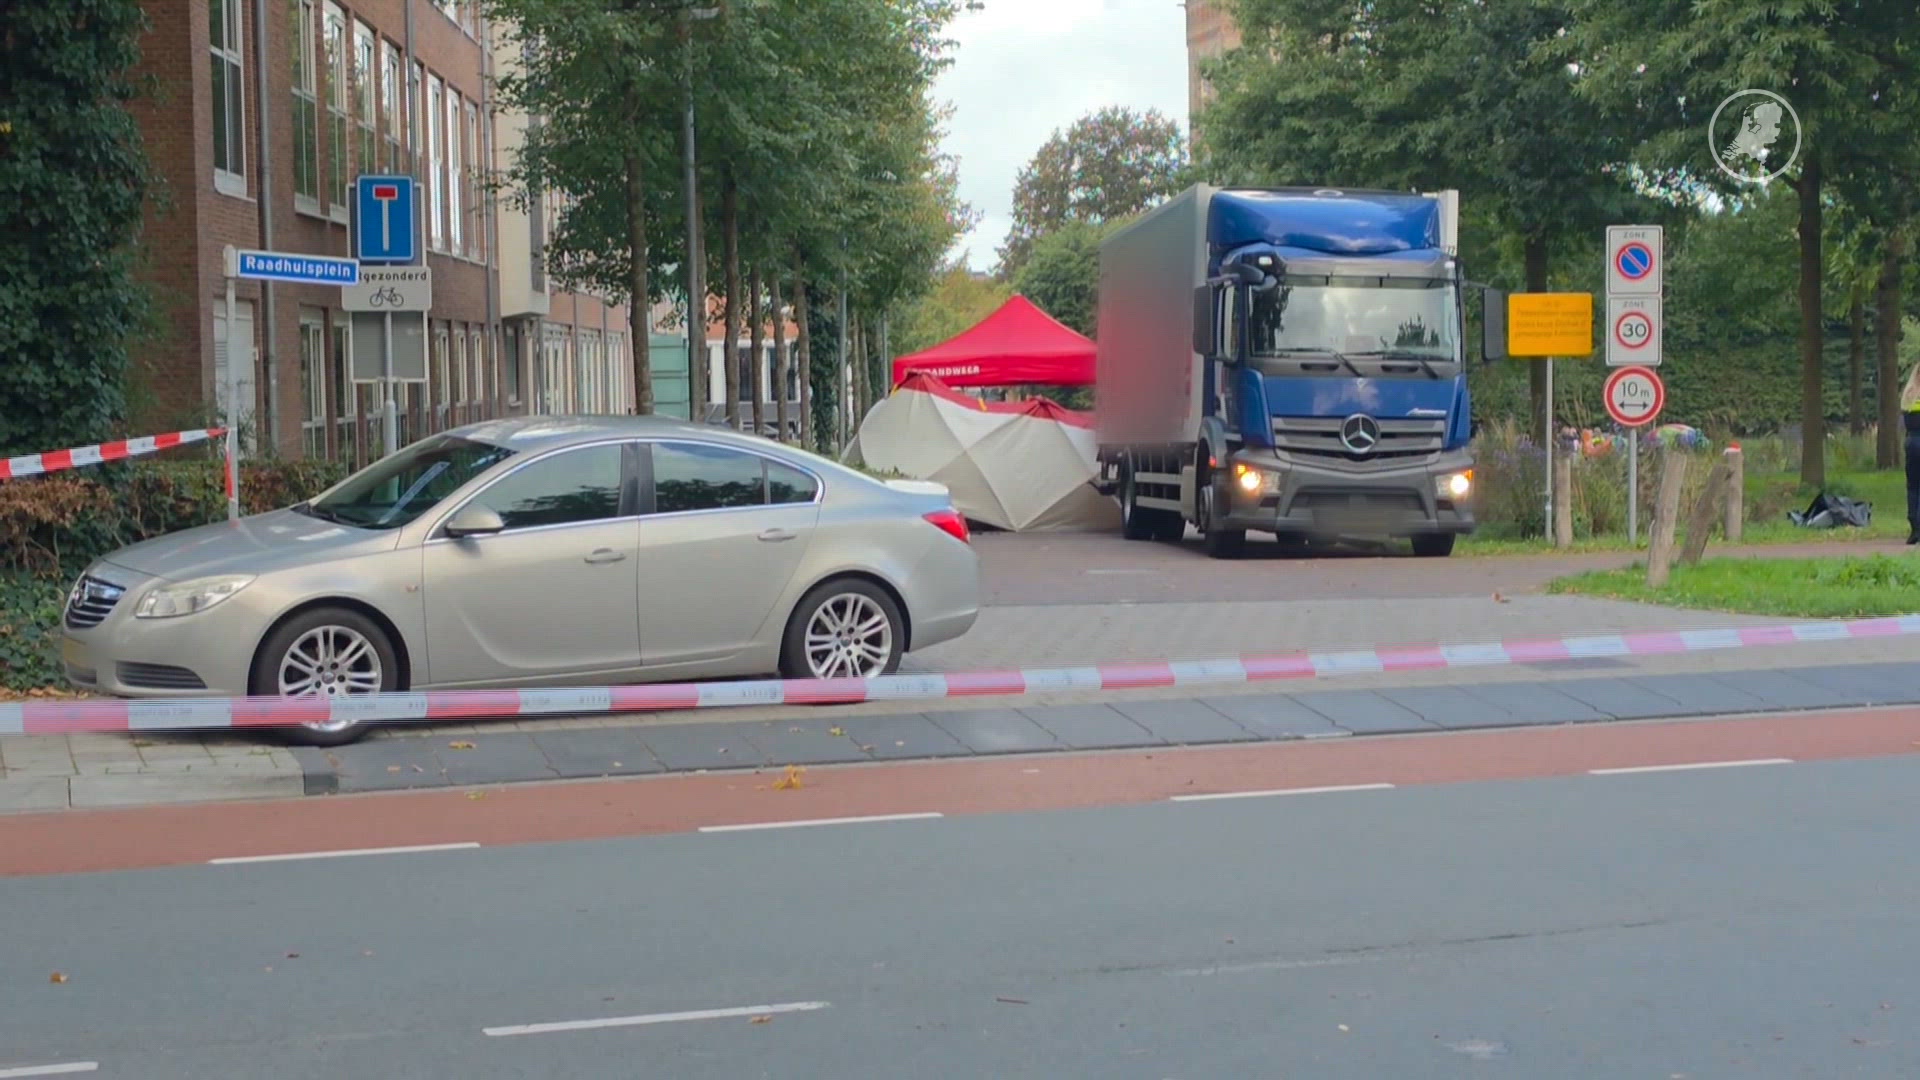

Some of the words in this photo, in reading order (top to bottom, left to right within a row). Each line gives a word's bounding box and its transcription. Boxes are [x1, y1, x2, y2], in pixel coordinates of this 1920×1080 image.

[1623, 231, 1645, 239] ZONE
[246, 255, 351, 277] Raadhuisplein
[357, 270, 428, 283] tgezonderd
[1622, 300, 1645, 308] ZONE
[1622, 323, 1647, 338] 30
[1622, 380, 1638, 397] 10
[1640, 389, 1650, 398] m
